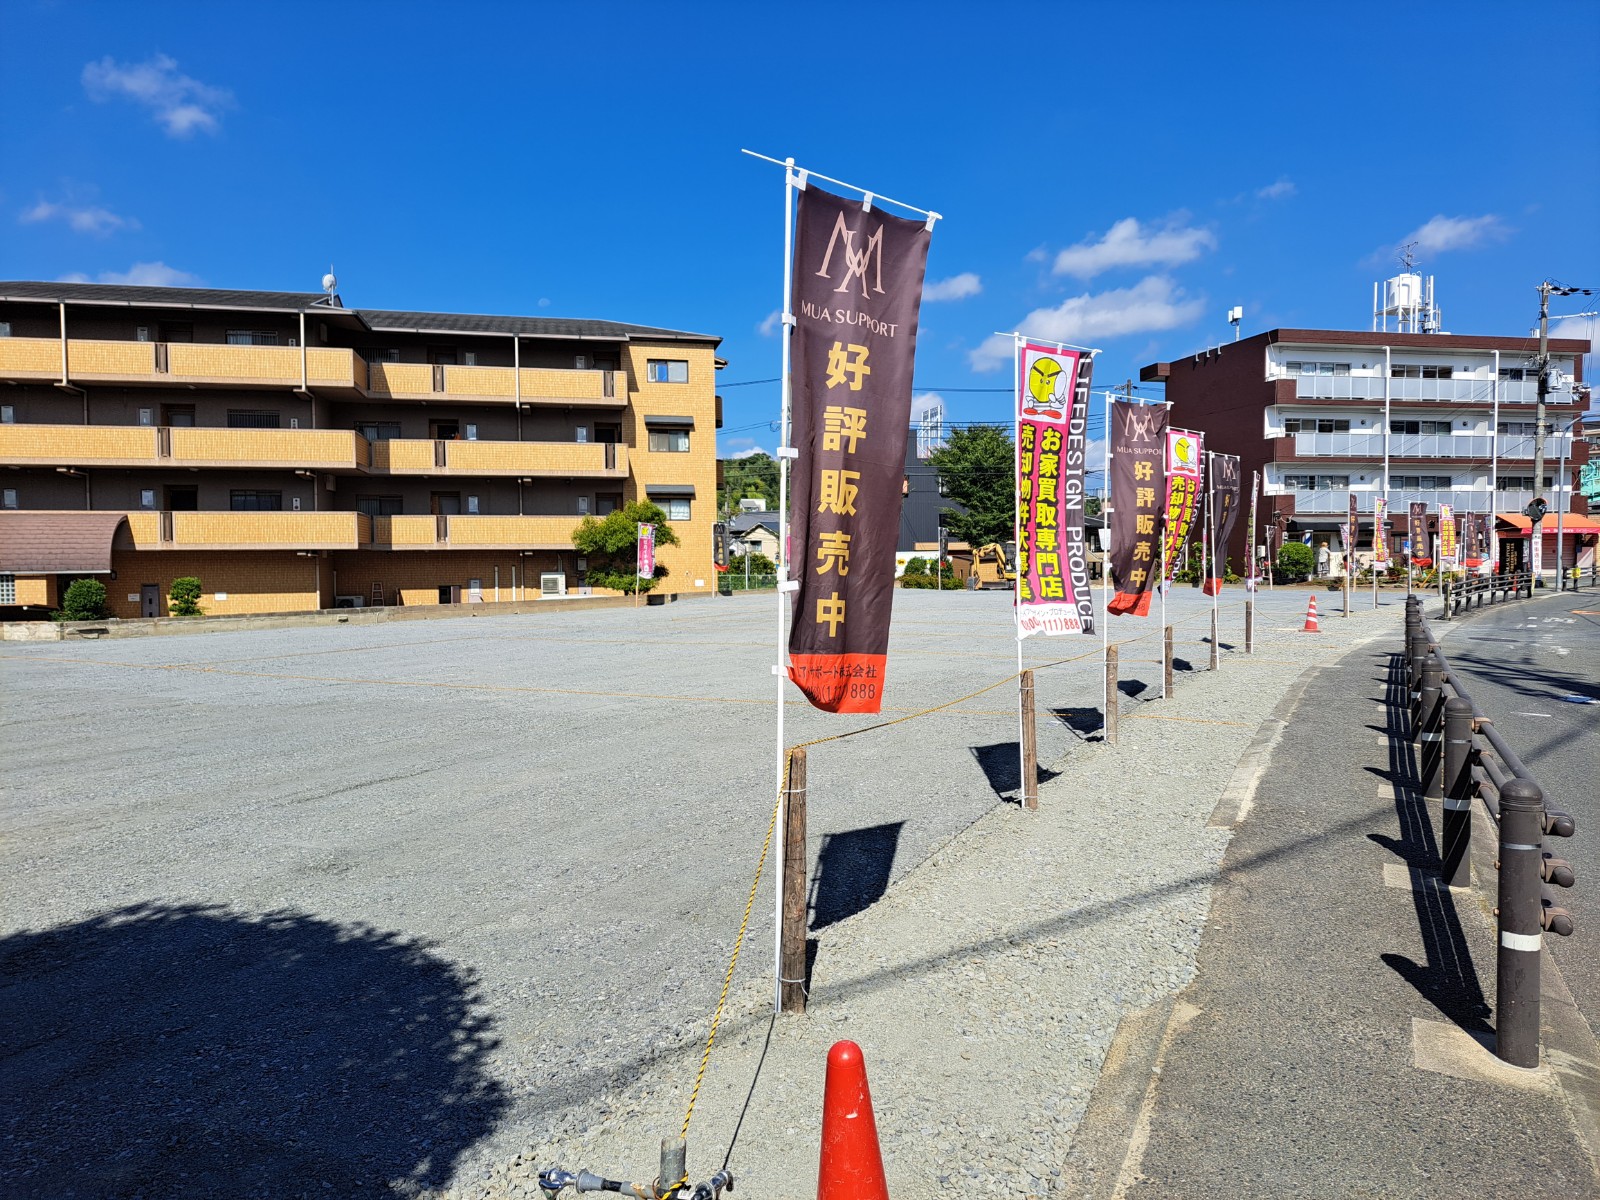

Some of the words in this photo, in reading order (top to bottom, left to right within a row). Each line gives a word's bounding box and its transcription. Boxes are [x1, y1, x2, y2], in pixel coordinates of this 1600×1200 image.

[801, 300, 832, 323] MUA
[835, 309, 899, 338] SUPPORT
[815, 341, 871, 638] 好評販売中
[1035, 427, 1063, 598] お家買取専門店
[1116, 445, 1133, 454] MUA
[1130, 461, 1155, 588] 好評販売中
